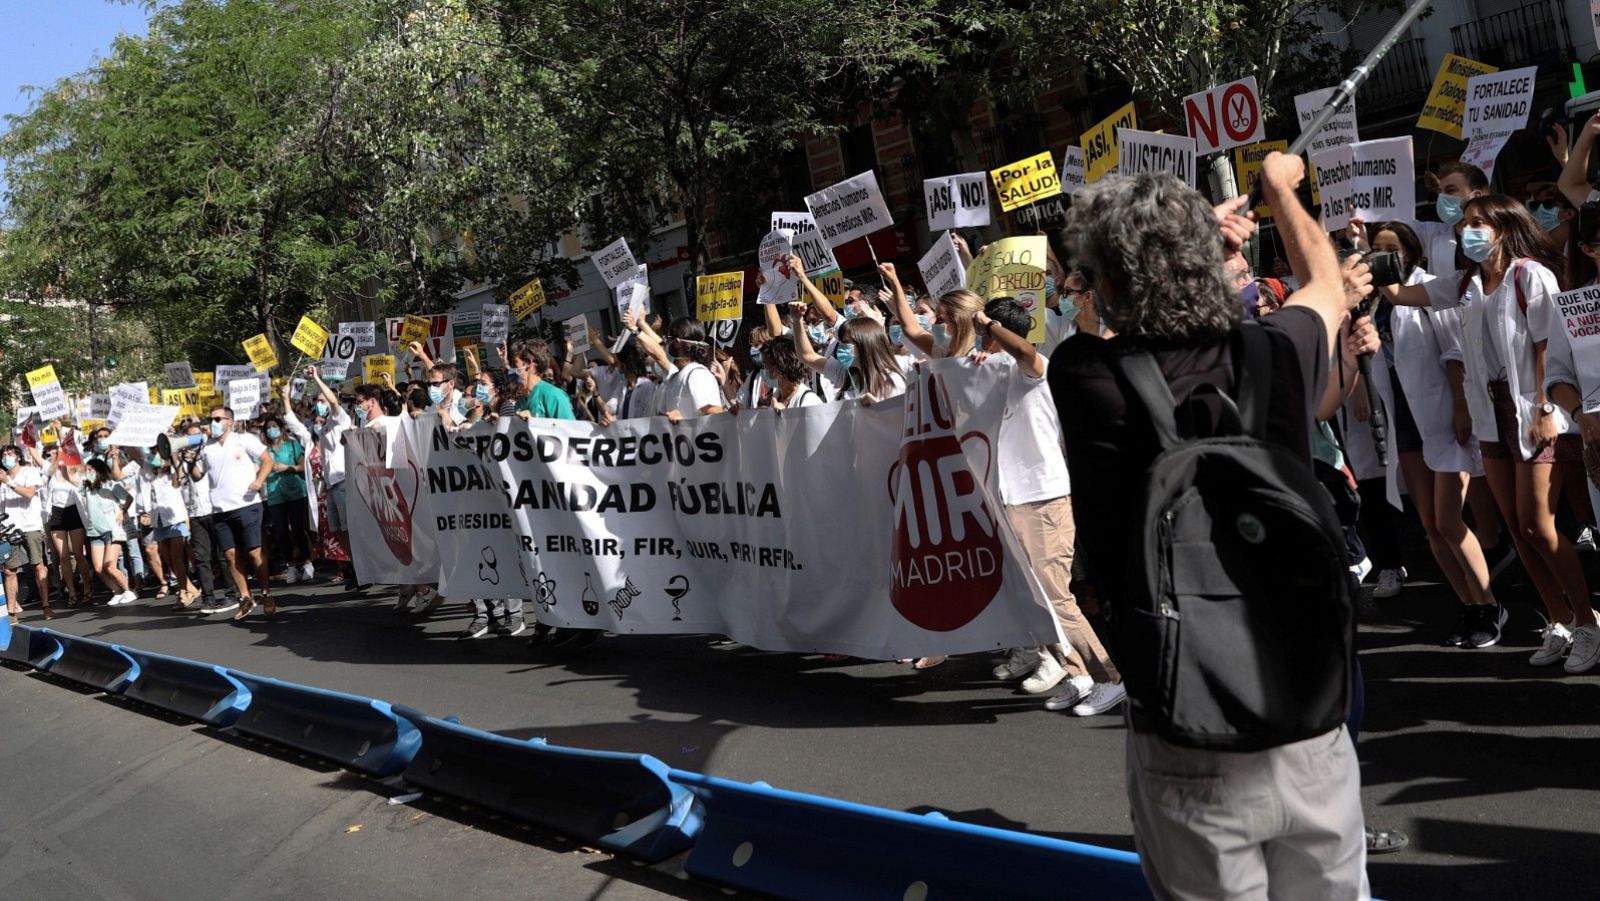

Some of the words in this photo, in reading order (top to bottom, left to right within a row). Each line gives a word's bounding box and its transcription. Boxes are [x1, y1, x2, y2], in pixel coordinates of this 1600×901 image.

[1473, 77, 1529, 100] FORTALECE
[1185, 83, 1258, 148] NO
[1301, 111, 1310, 122] No
[1468, 107, 1478, 123] TU
[1483, 100, 1527, 121] SANIDAD.
[1086, 124, 1110, 172] ¡ASÍ,
[1312, 139, 1324, 150] sin
[996, 164, 1030, 188] ¡Por
[1036, 156, 1052, 171] la
[1317, 161, 1352, 187] Derecho
[1352, 157, 1396, 178] humanos
[929, 182, 956, 219] ¡ASÍ,
[960, 180, 985, 209] NO!
[1000, 173, 1059, 203] SALUD!
[810, 197, 841, 220] Derechos
[840, 187, 869, 209] humanos
[1324, 202, 1330, 218] a
[1331, 197, 1342, 215] los
[1373, 187, 1396, 209] MIR.
[821, 230, 827, 240] a
[828, 225, 836, 239] los
[834, 214, 861, 236] médicos
[860, 207, 878, 227] MIR.
[598, 244, 628, 267] FORTALECE
[994, 249, 1032, 268] SOLO
[718, 278, 741, 292] médico
[823, 277, 842, 296] NO!
[990, 272, 1046, 293] DERECHOS
[1557, 292, 1581, 306] QUE
[1567, 319, 1575, 329] A
[323, 335, 355, 360] NO
[186, 392, 199, 405] NO!
[668, 477, 781, 518] PÚBLICA
[437, 515, 457, 531] DE
[581, 538, 625, 560] BIR,
[634, 538, 682, 559] FIR,
[686, 540, 728, 563] QUIR,
[759, 547, 803, 571] RFIR.
[890, 547, 996, 590] MADRID
